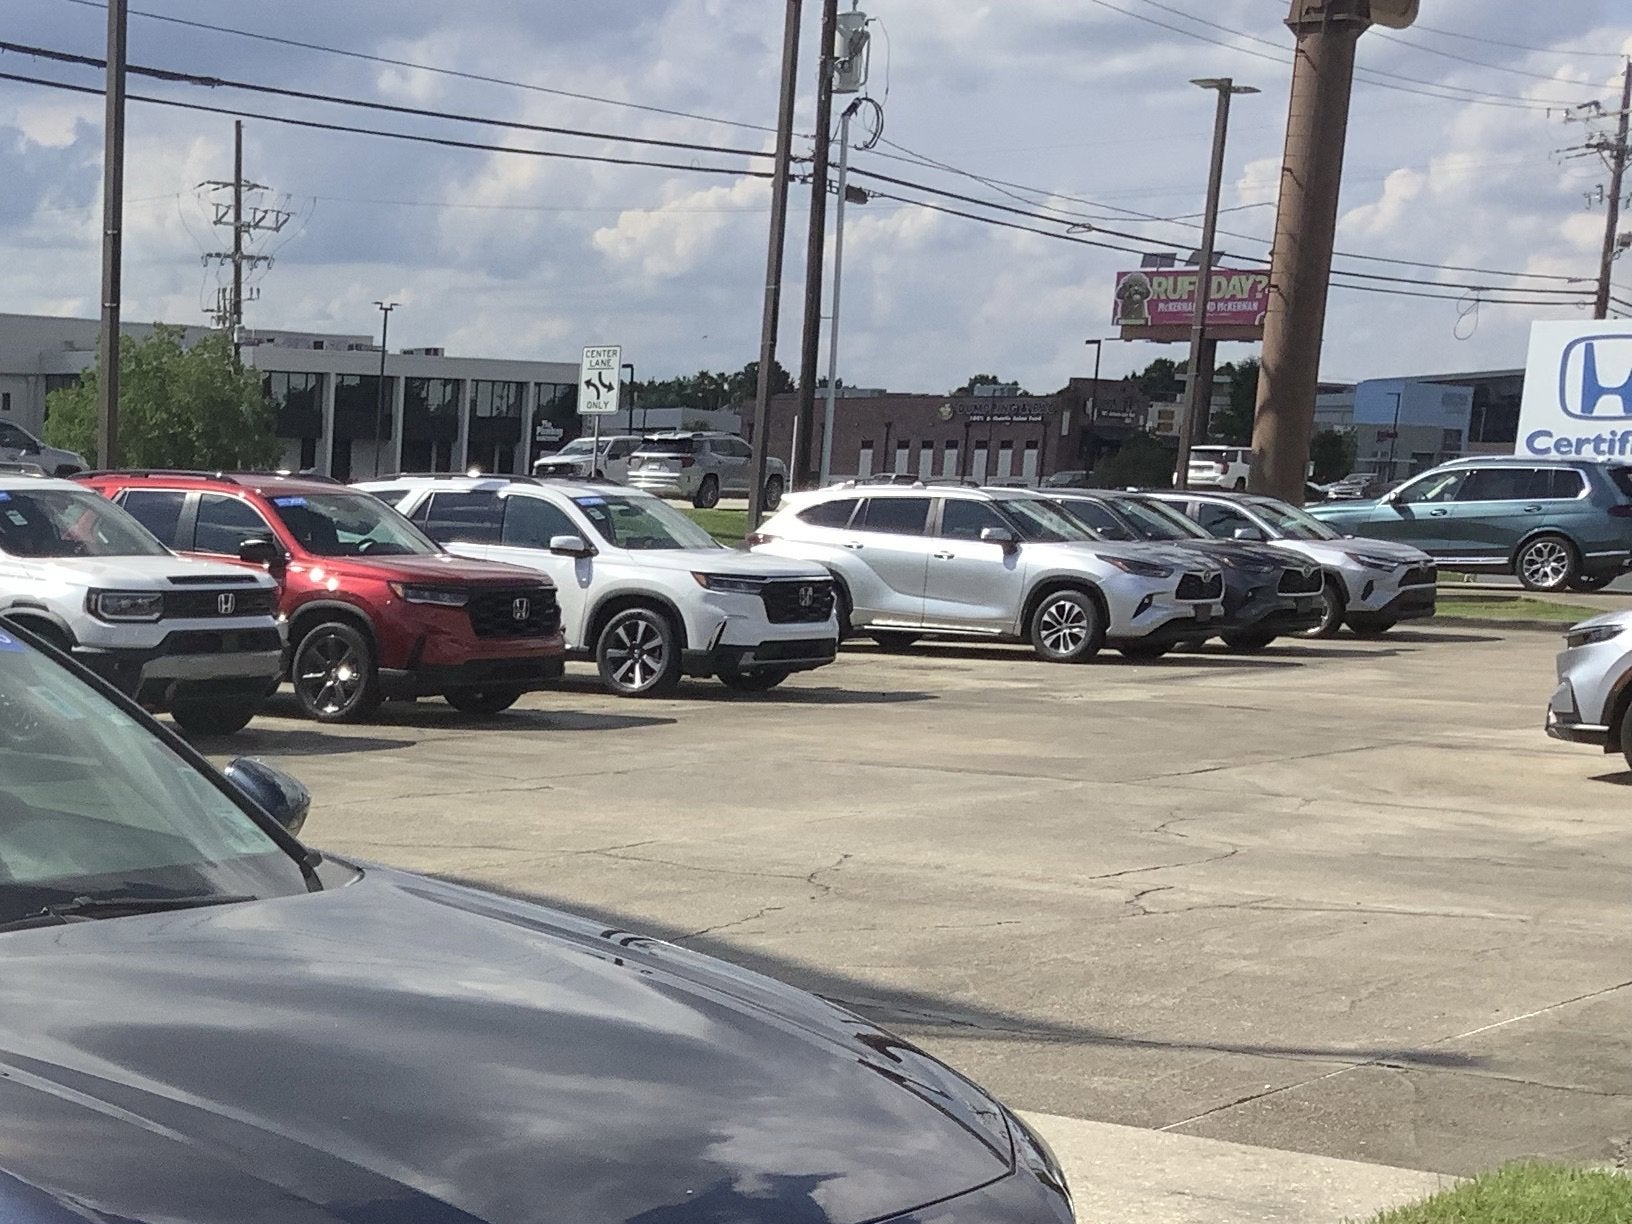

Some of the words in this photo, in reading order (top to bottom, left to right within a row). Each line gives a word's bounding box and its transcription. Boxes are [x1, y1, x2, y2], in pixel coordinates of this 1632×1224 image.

[1152, 275, 1198, 300] RUF
[1210, 274, 1268, 300] DAY?
[1158, 301, 1196, 312] McKERNA
[585, 350, 618, 358] CENTER
[586, 401, 609, 409] ONLY
[1525, 429, 1632, 456] Certif
